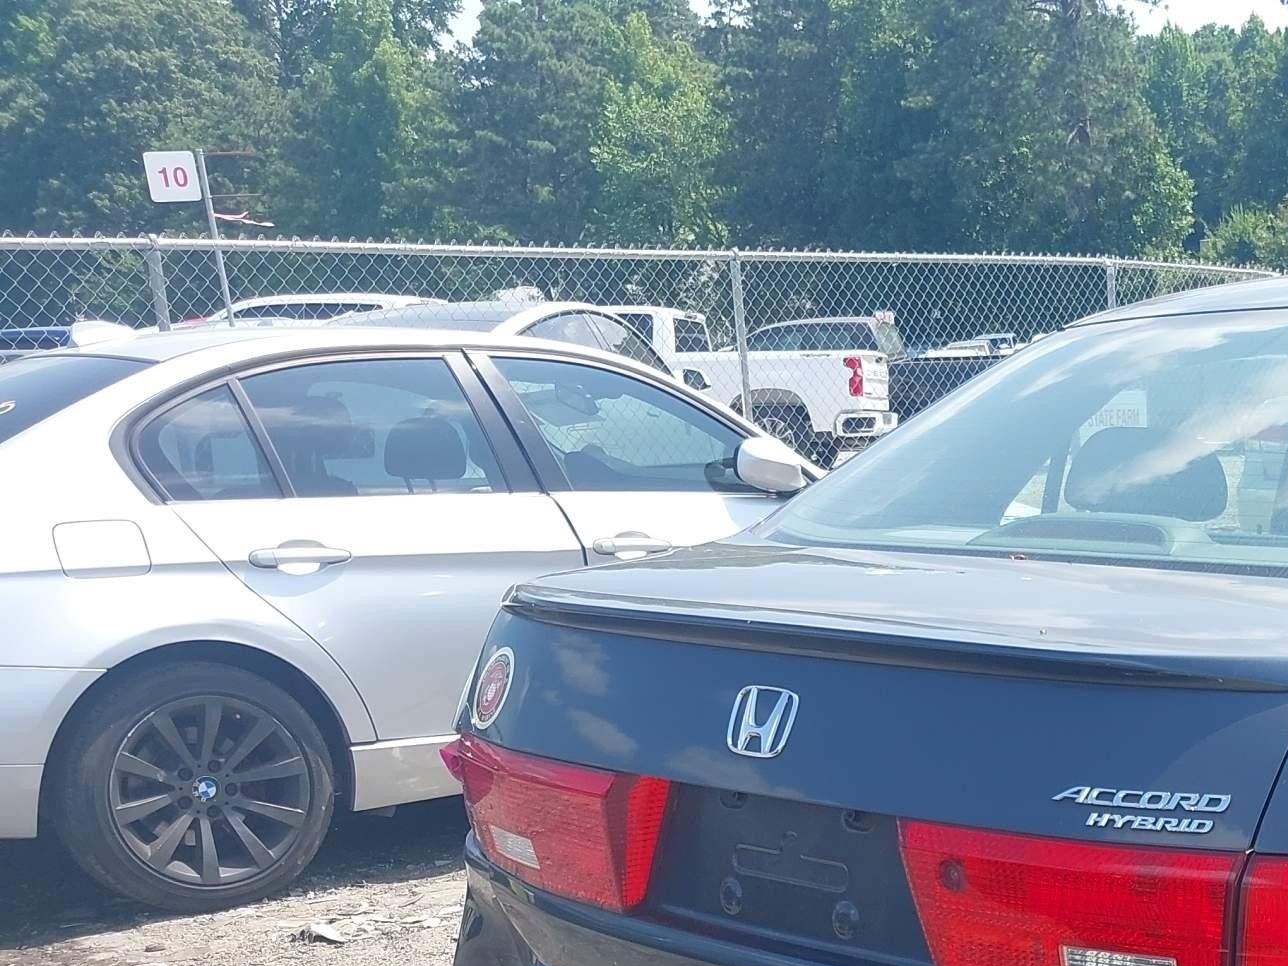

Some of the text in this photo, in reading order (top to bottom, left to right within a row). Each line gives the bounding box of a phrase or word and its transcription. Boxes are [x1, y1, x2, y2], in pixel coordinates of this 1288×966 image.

[157, 166, 189, 188] 10
[1051, 785, 1232, 813] ACCORD
[1085, 812, 1214, 834] HYBRID
